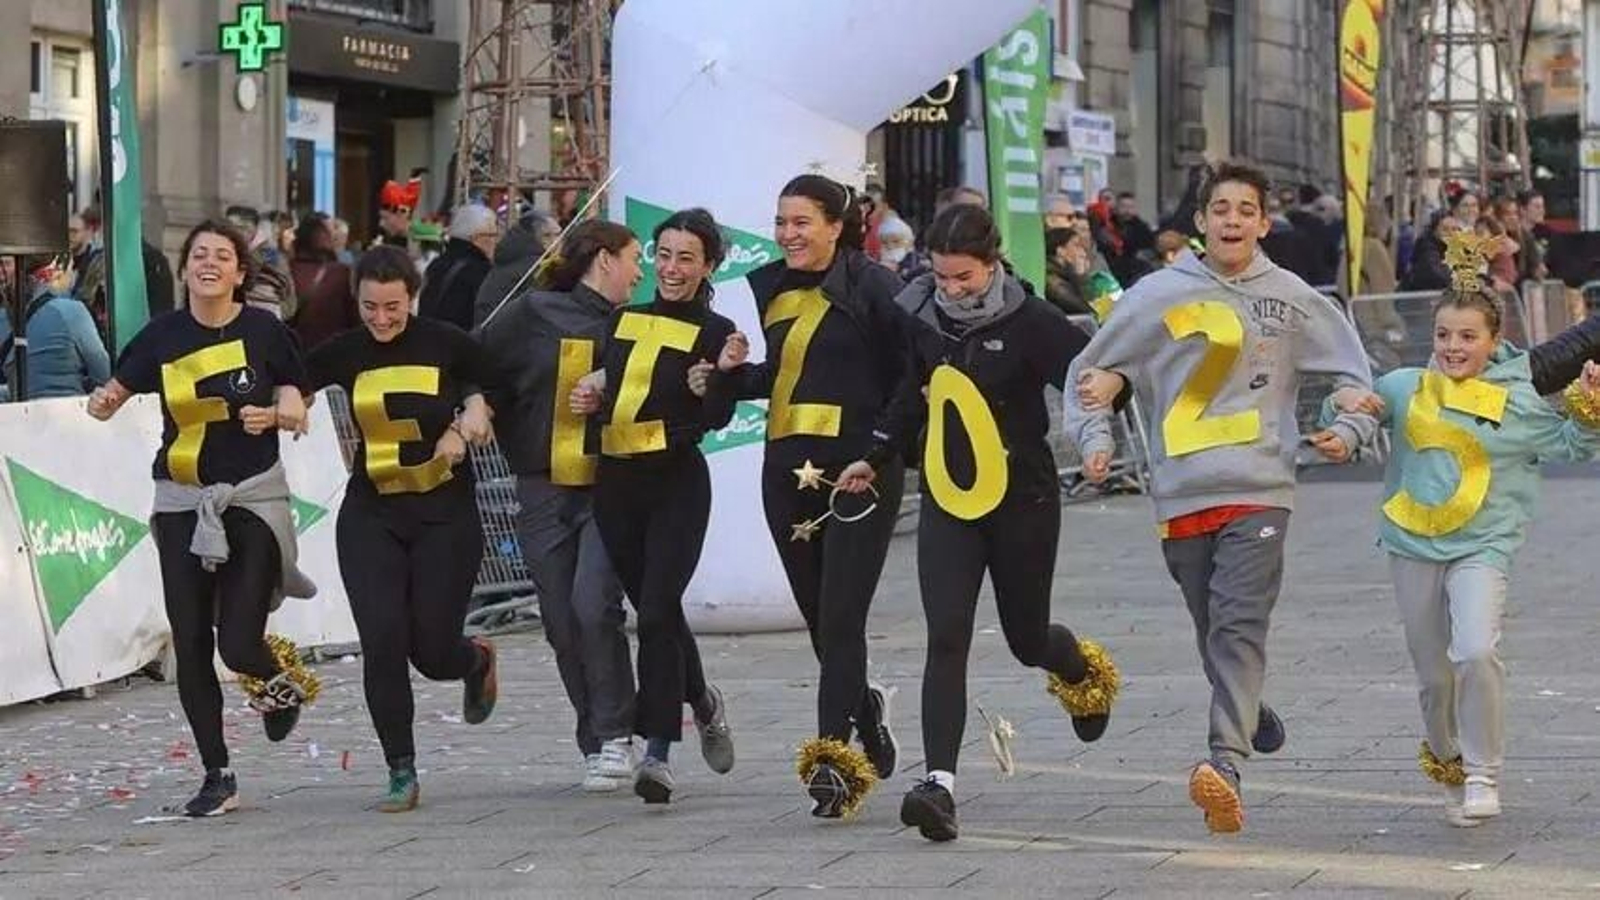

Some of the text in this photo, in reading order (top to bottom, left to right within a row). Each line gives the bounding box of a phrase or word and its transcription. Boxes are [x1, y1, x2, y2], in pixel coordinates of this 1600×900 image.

[342, 35, 410, 61] FARMACIA
[160, 340, 248, 486] F
[352, 364, 455, 495] E
[1162, 300, 1261, 457] 2
[1382, 368, 1508, 536] 5
